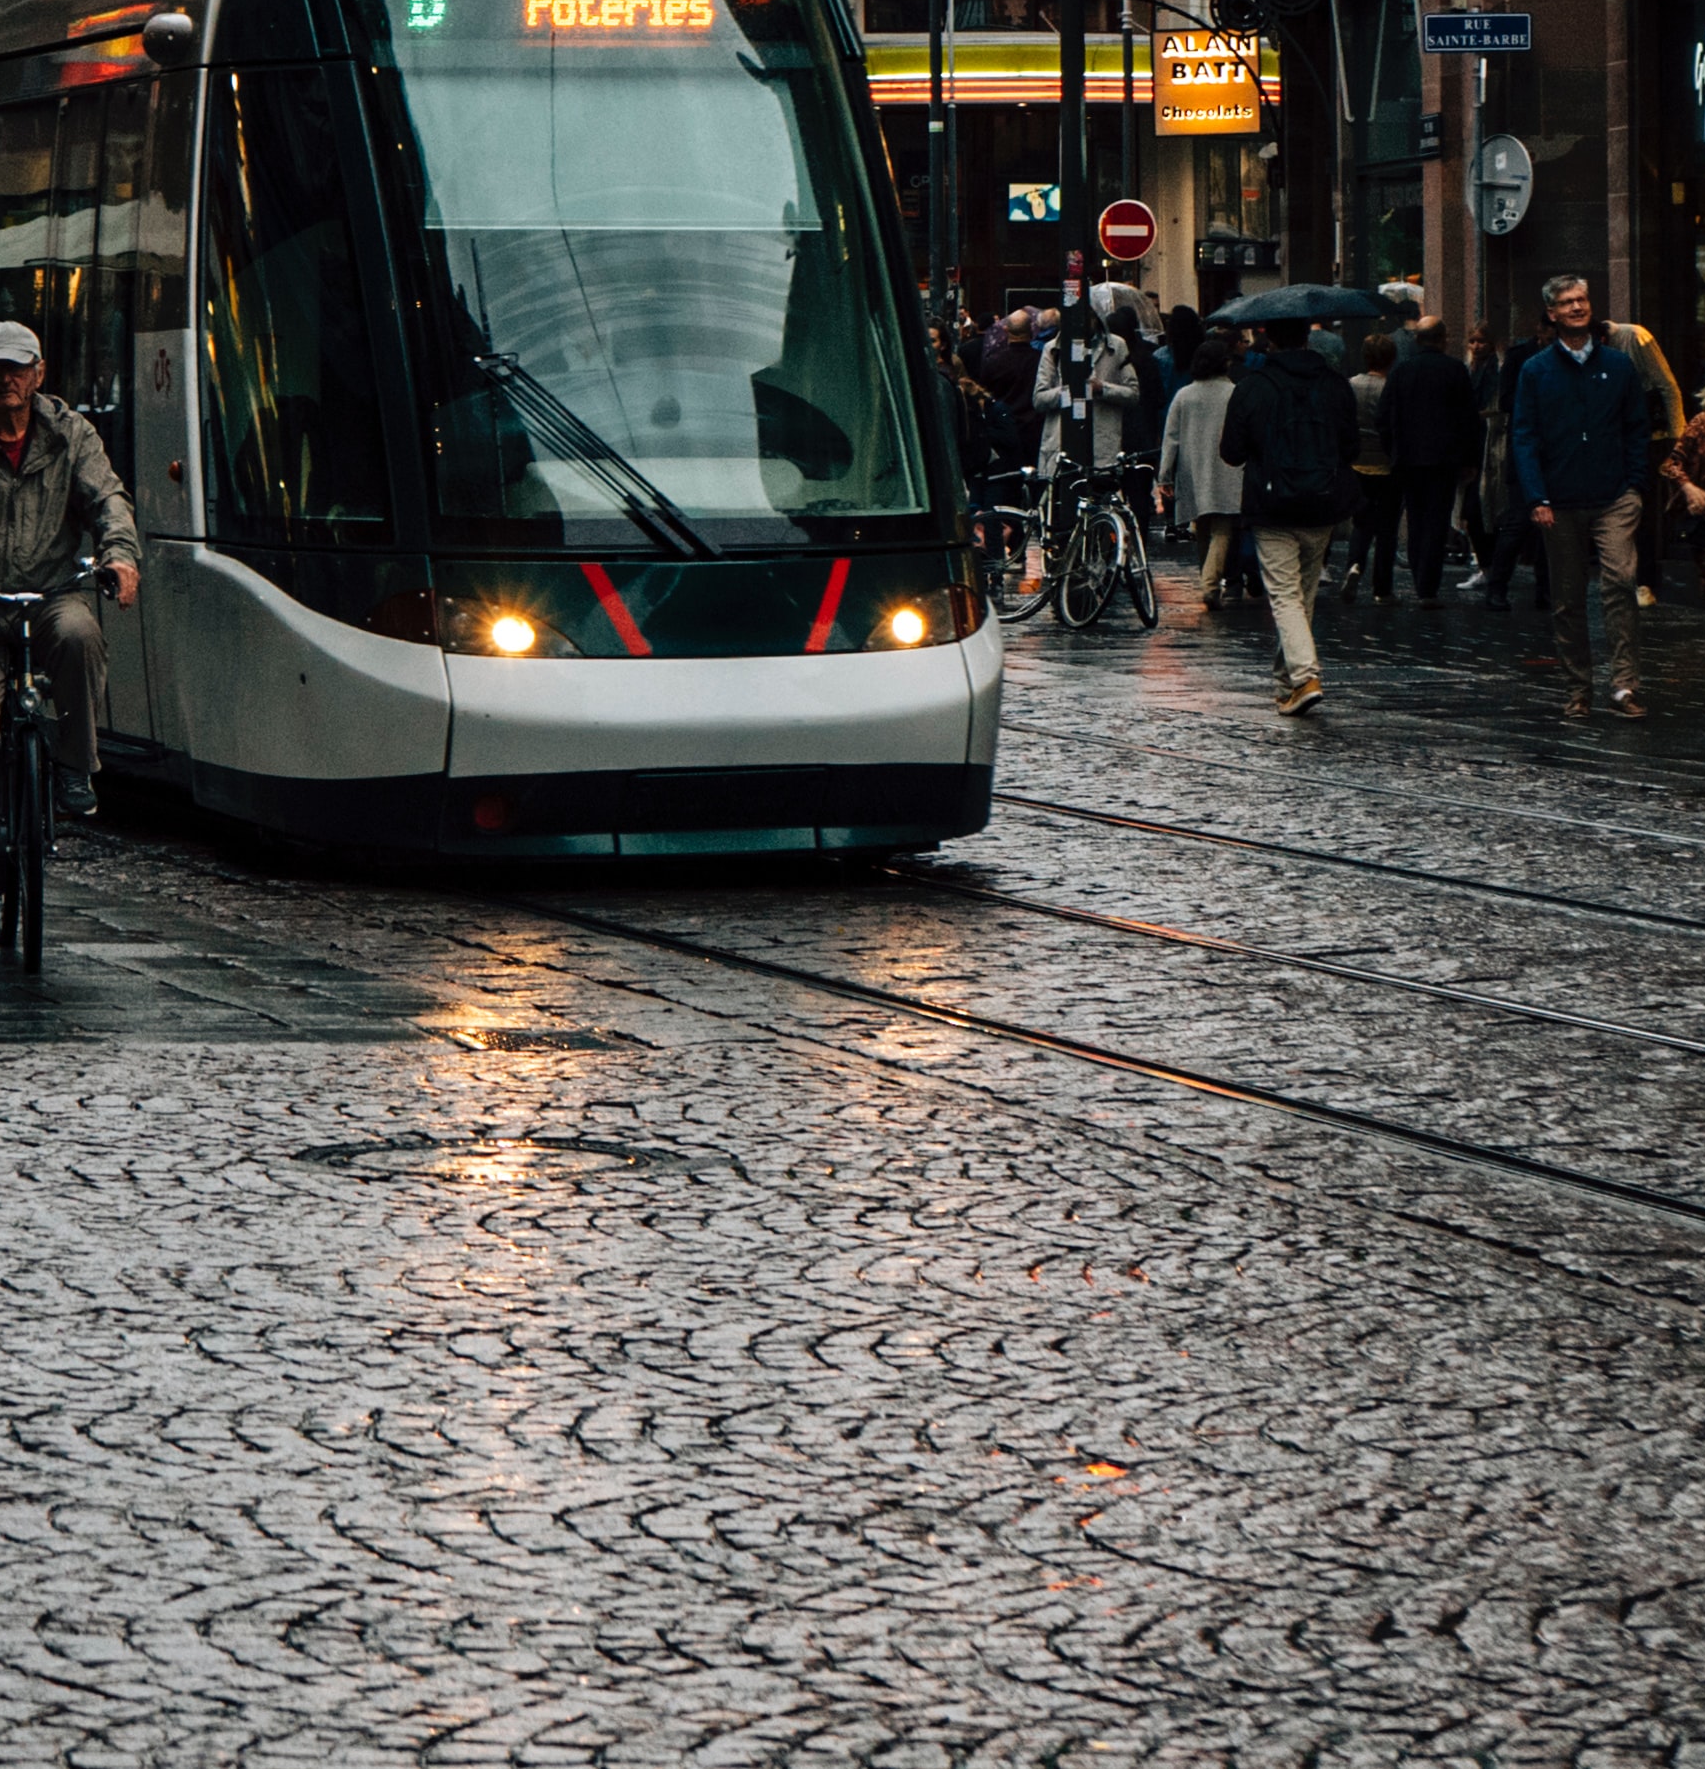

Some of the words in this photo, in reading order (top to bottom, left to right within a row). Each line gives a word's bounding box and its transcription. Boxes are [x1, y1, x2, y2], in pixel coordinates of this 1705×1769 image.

[1463, 18, 1492, 31] RUE
[1162, 35, 1257, 58] ALAIN
[1427, 33, 1528, 47] SAINTE-BARBE
[1171, 61, 1247, 84] BATT
[1161, 103, 1254, 121] Chocolats
